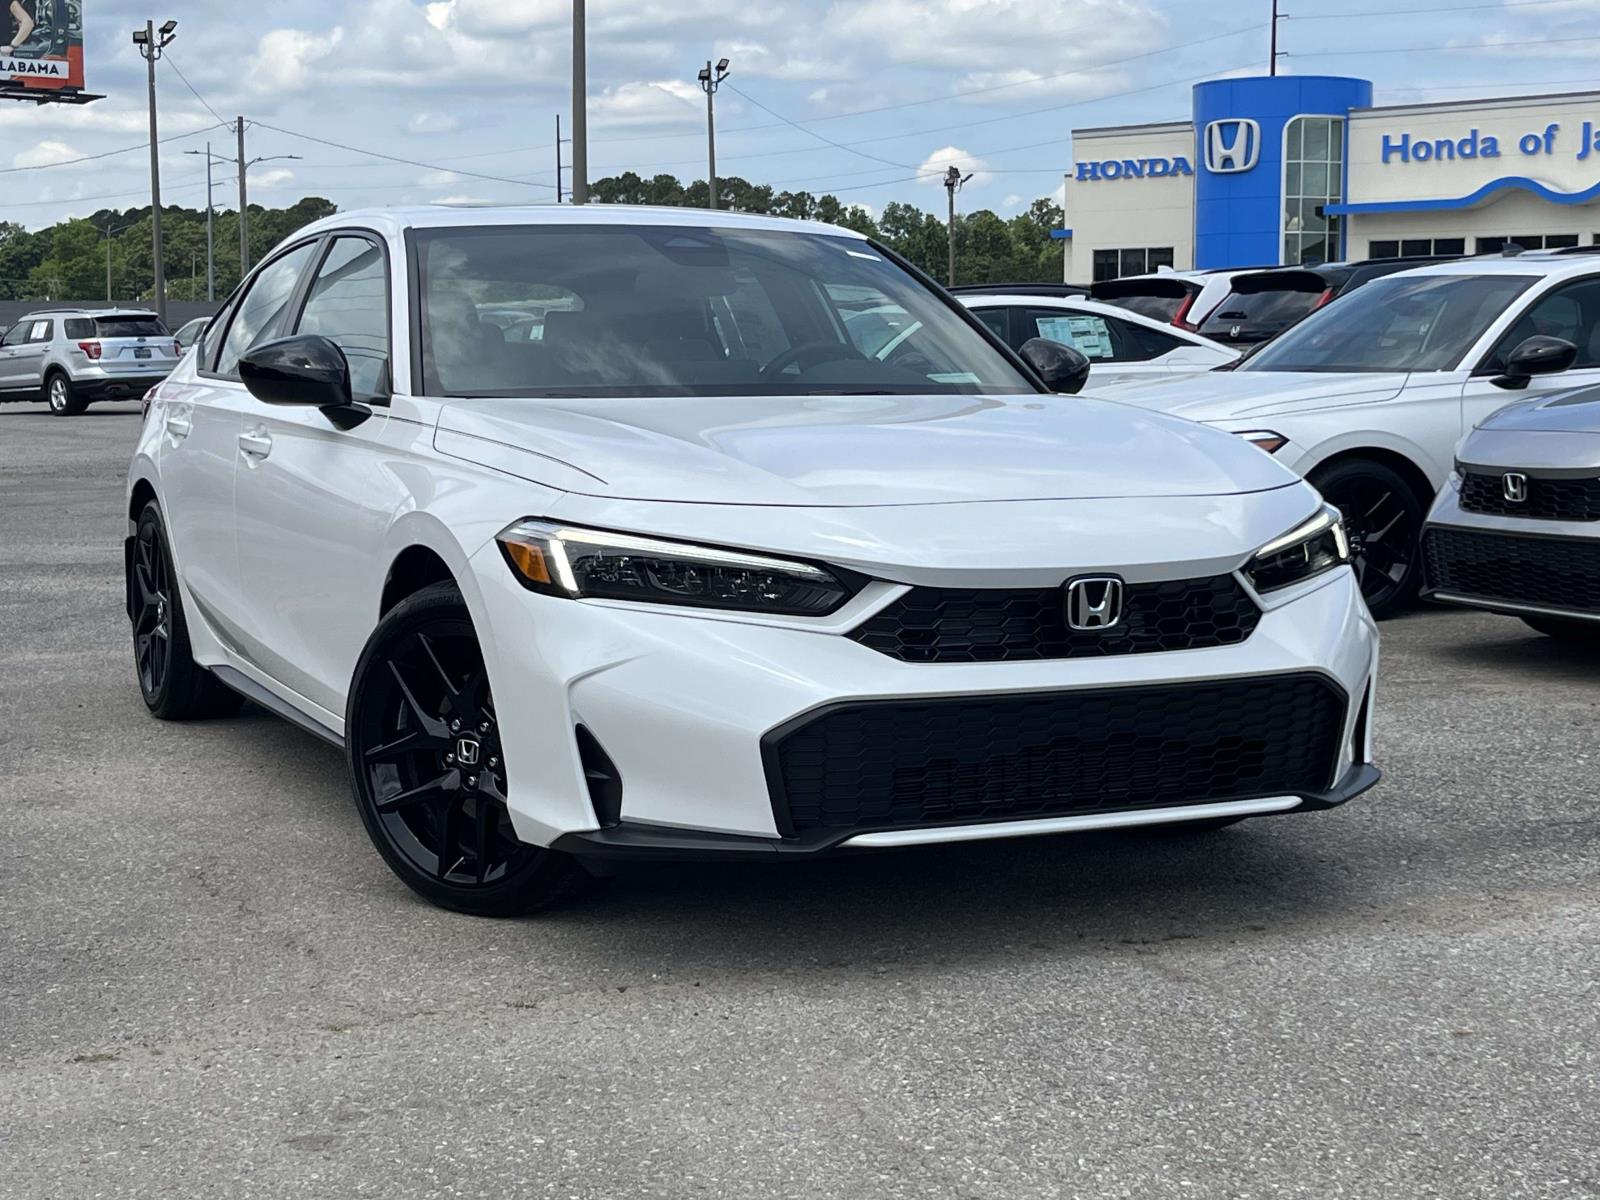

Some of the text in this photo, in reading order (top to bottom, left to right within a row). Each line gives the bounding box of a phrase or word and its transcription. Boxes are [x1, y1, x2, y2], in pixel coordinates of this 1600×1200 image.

[1381, 128, 1501, 164] Honda
[1519, 123, 1560, 156] of
[1075, 157, 1194, 181] HONDA
